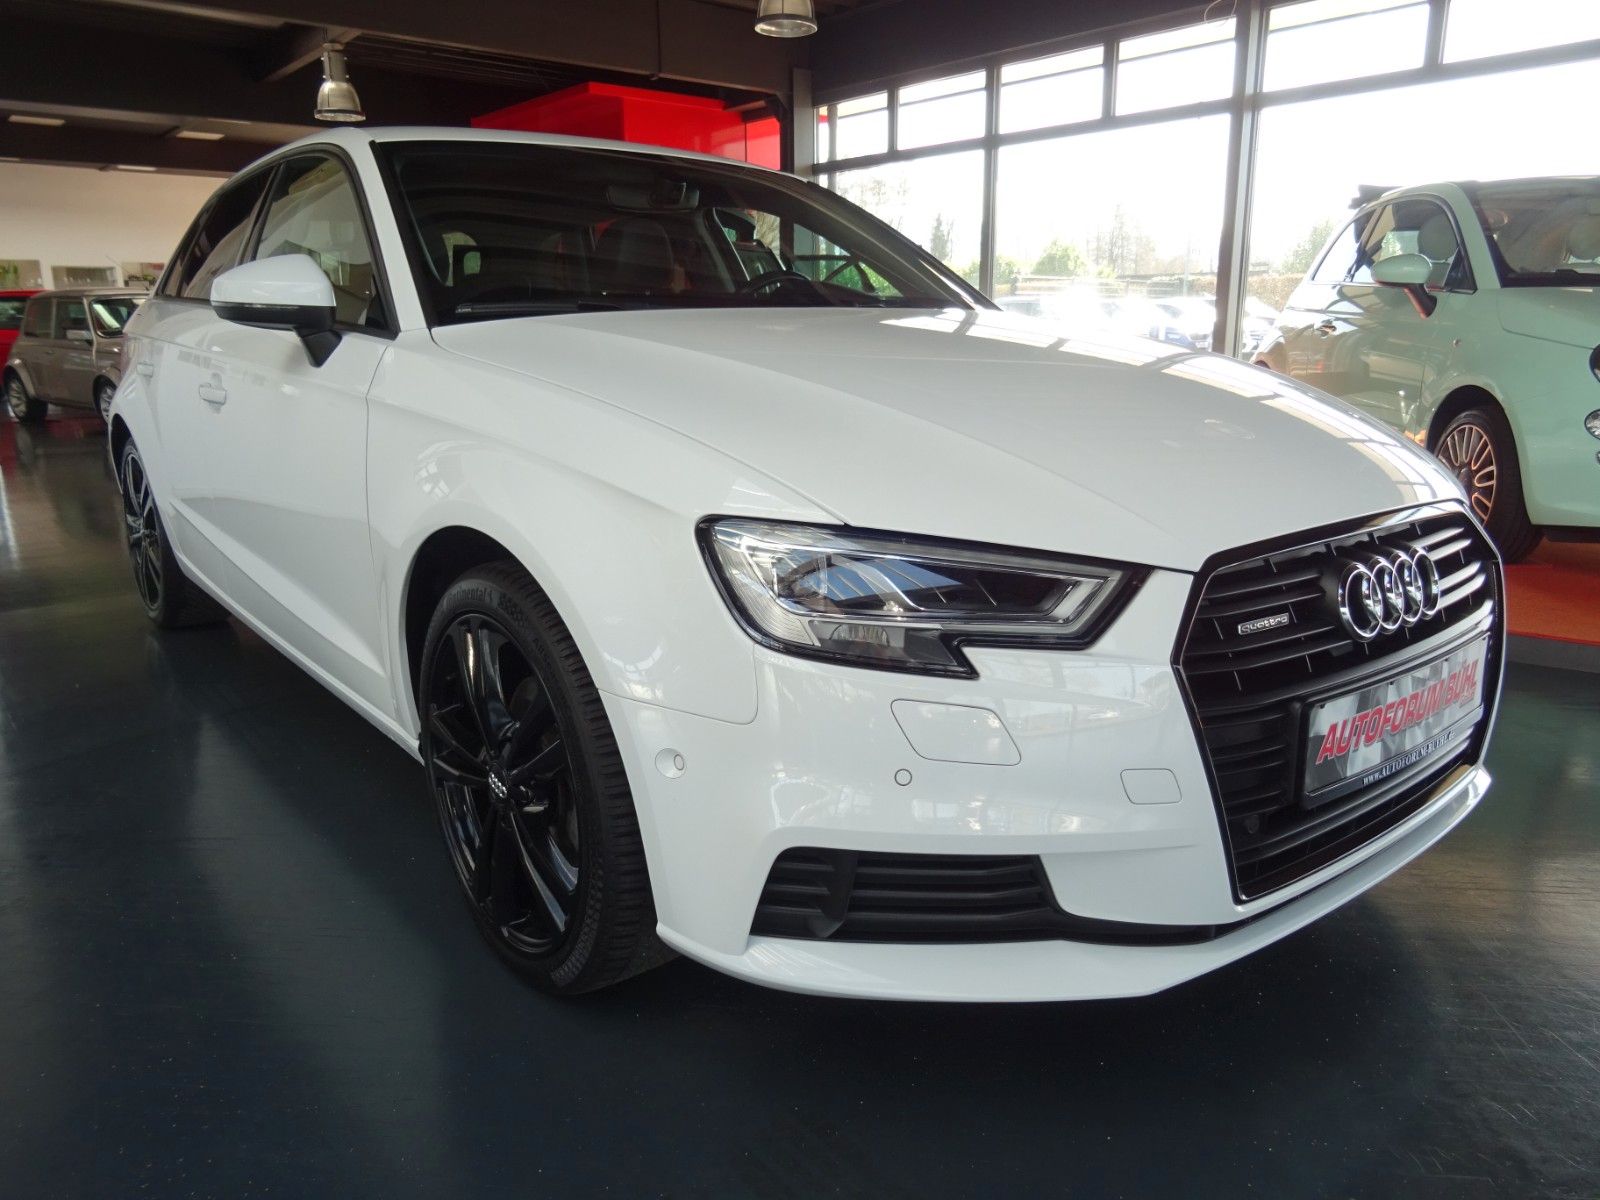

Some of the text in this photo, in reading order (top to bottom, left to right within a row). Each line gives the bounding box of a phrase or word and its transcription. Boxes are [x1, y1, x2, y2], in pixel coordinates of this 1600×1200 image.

[1241, 616, 1288, 633] quattro
[1315, 659, 1479, 765] AUTOFORUM BÜHL
